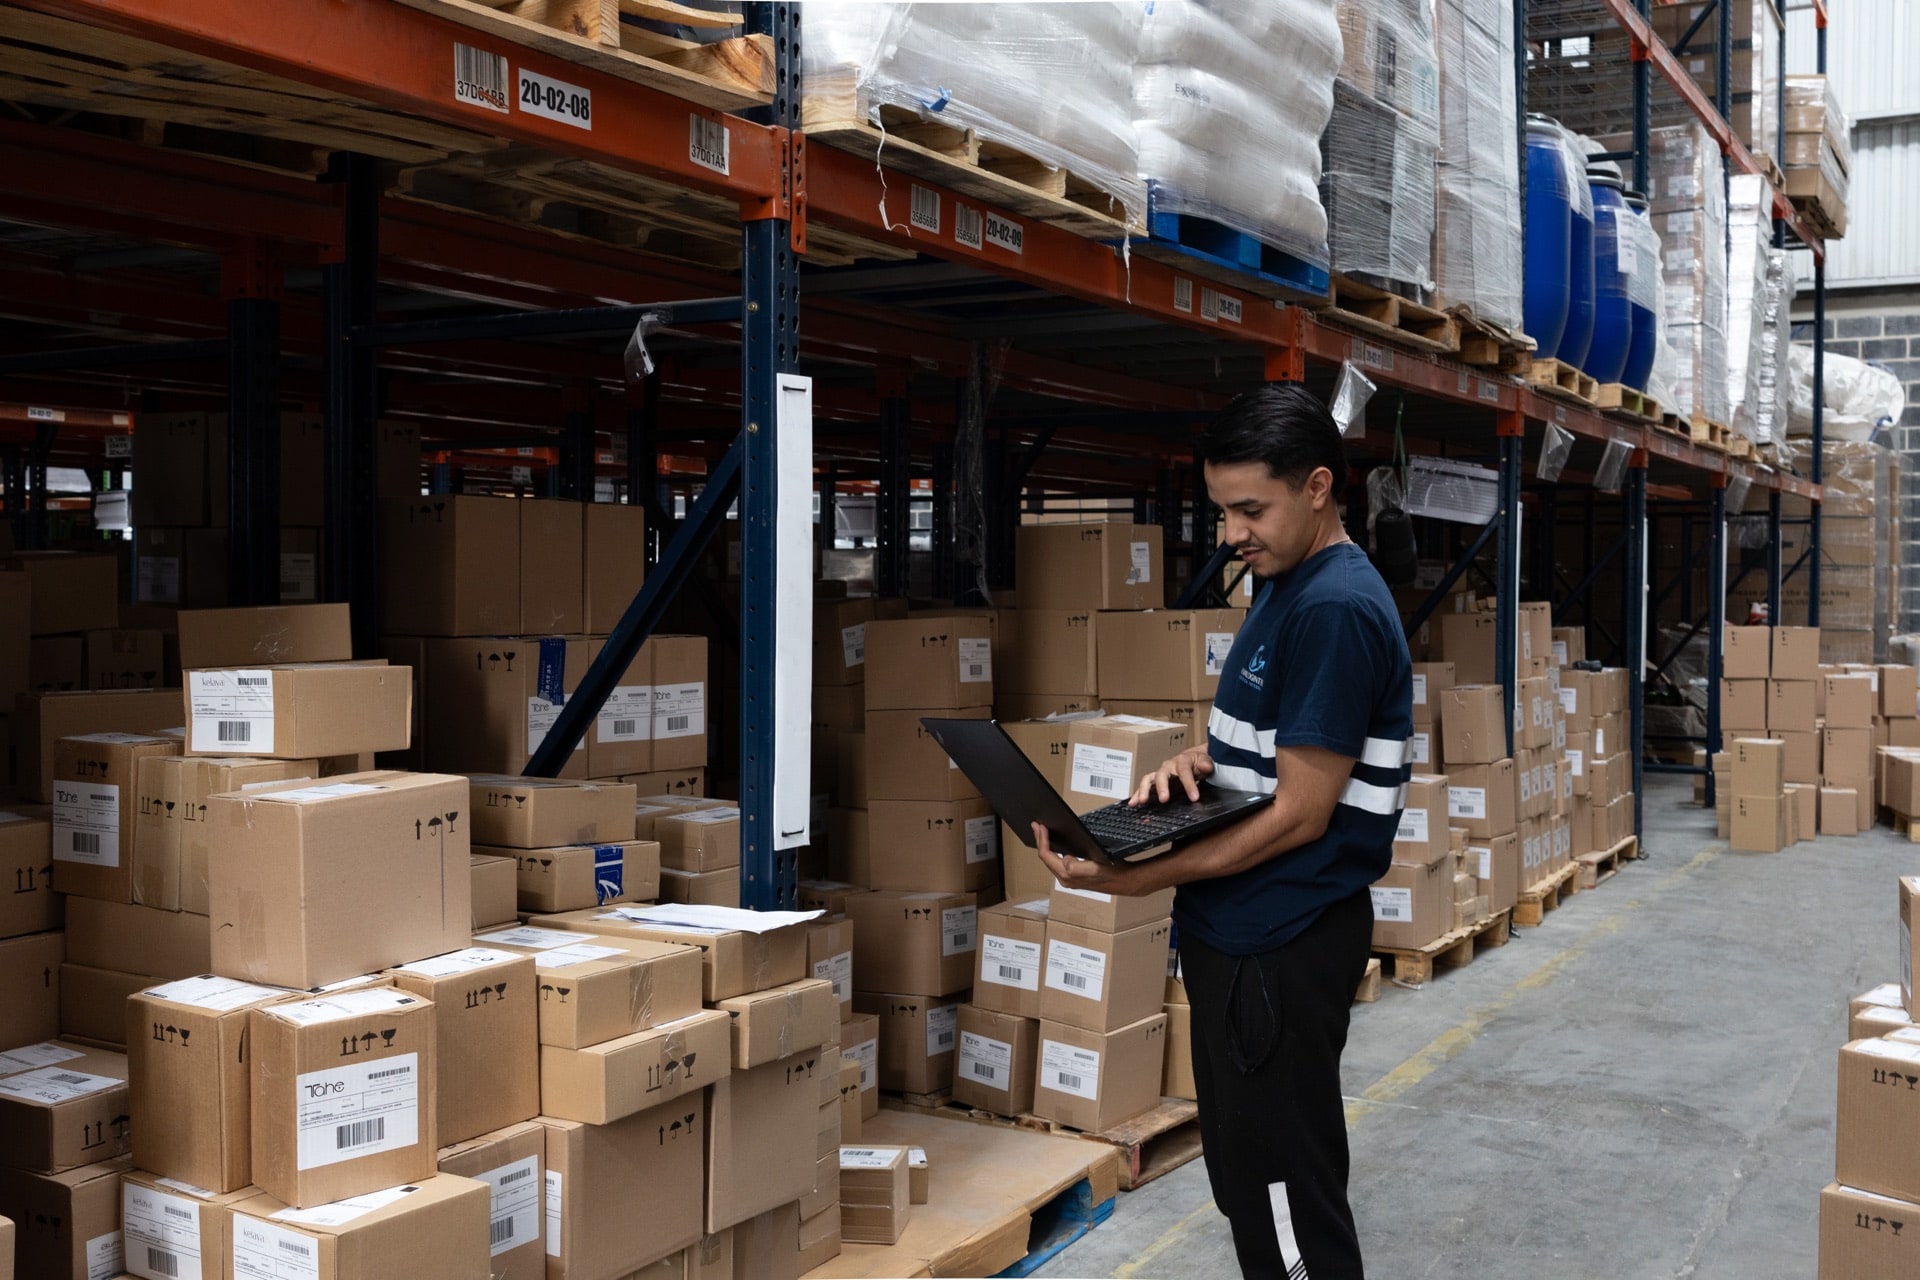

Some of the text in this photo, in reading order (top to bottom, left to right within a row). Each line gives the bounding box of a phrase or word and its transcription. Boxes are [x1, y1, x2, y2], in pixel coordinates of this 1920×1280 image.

[521, 78, 590, 120] 20-02-08
[691, 144, 726, 170] 37D01AA
[987, 218, 1022, 248] 20-02-09
[304, 1081, 345, 1098] Tahe
